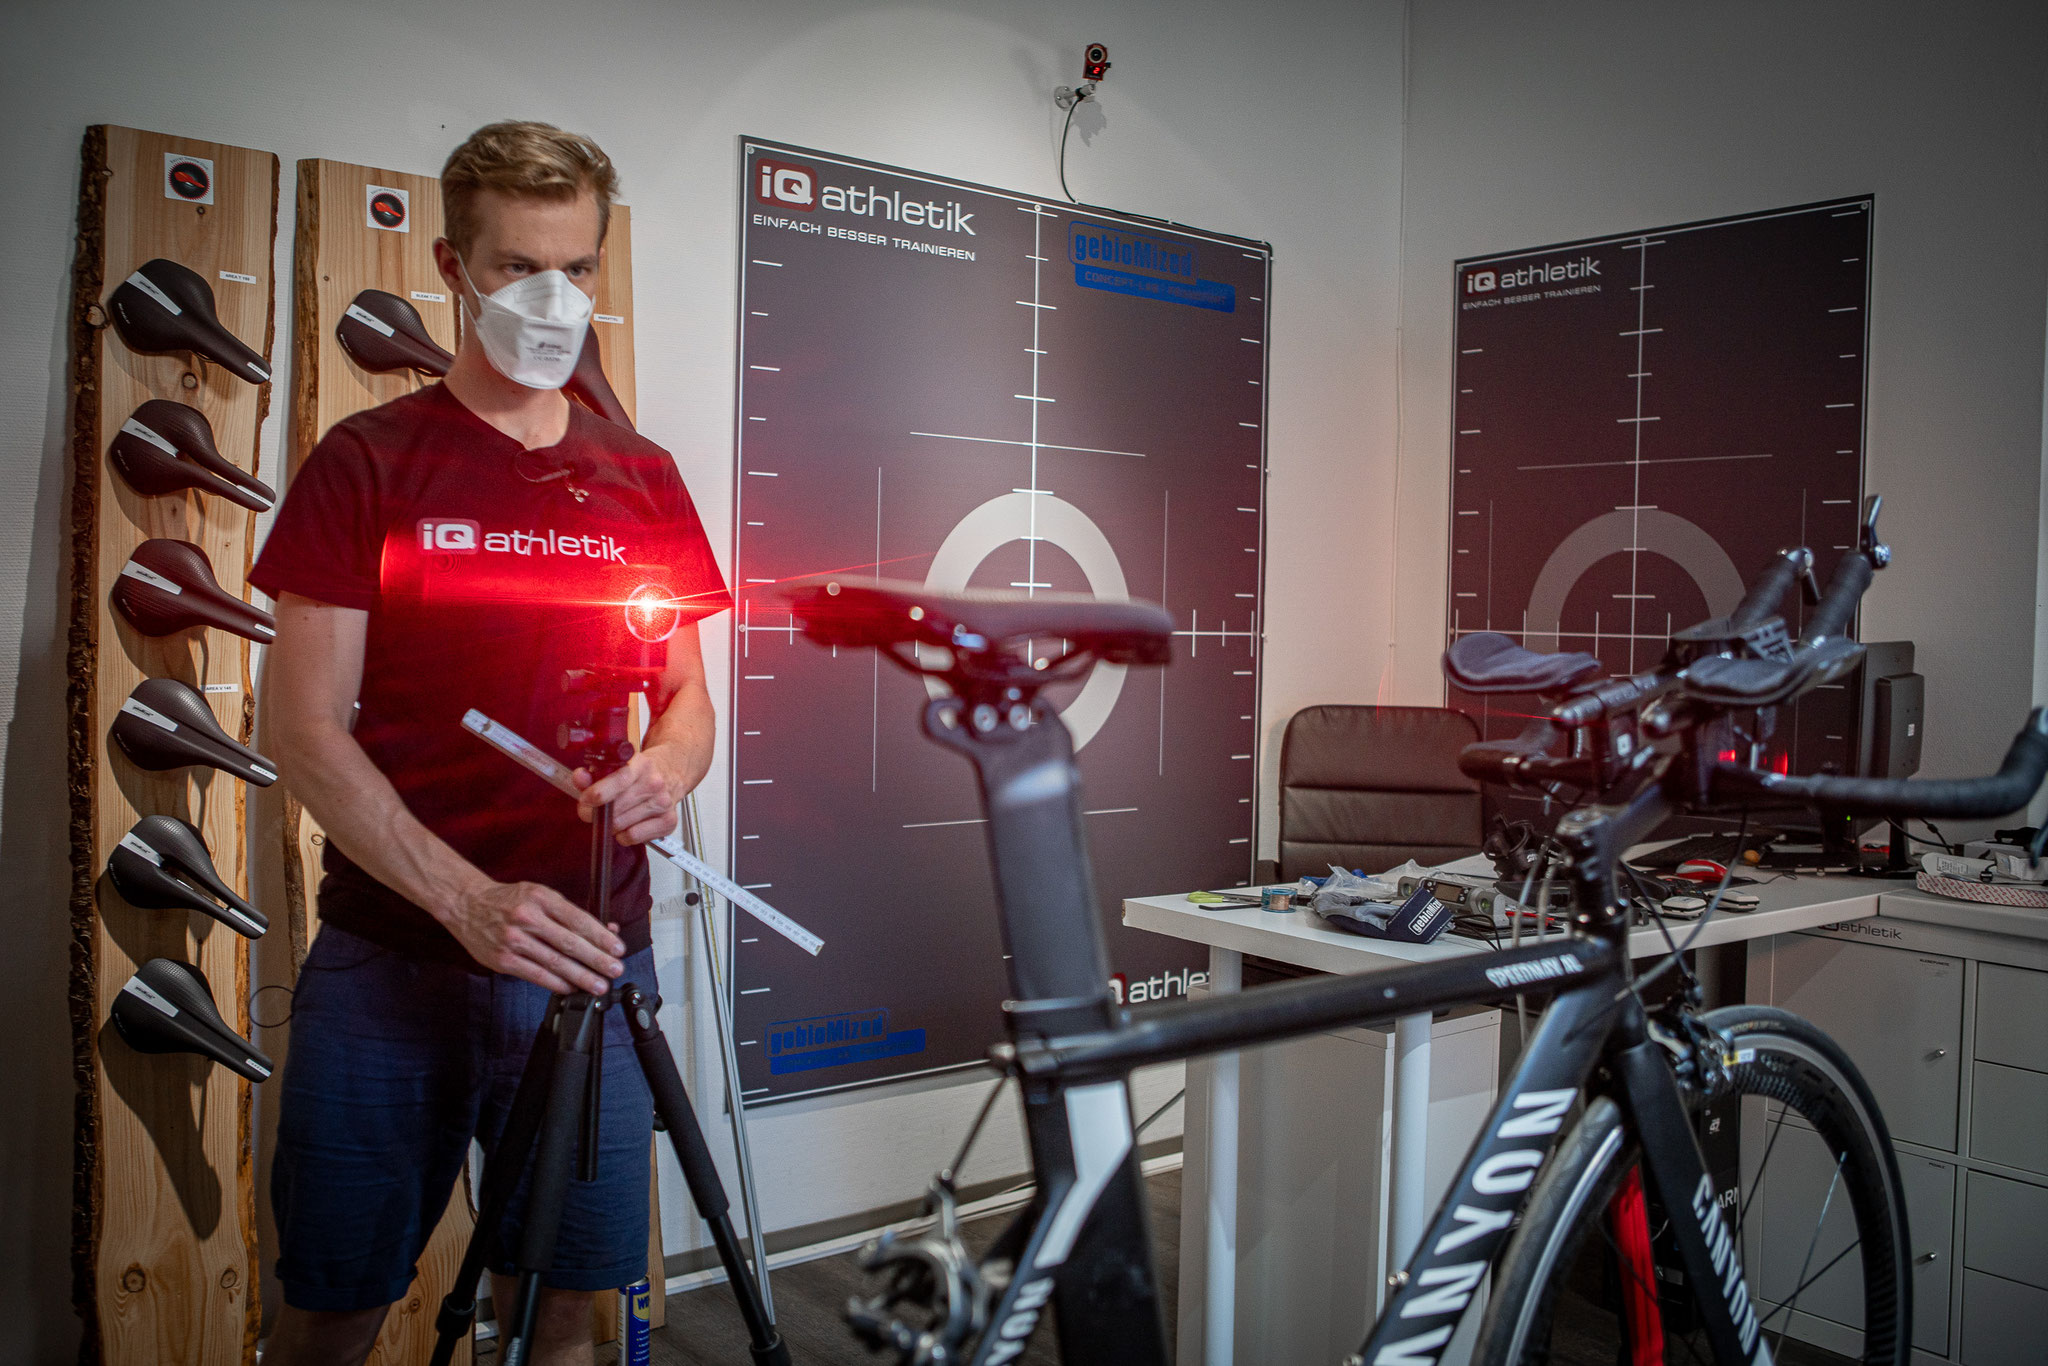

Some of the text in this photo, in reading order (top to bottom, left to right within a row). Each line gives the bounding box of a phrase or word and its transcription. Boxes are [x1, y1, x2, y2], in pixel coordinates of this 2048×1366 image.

[761, 165, 976, 236] iQ athletik
[752, 213, 976, 261] EINFACH BESSER TRAINIEREN
[1074, 233, 1192, 277] gebioMized
[1466, 255, 1602, 294] iQ athletik
[1462, 284, 1602, 311] EINFACH BESSER TRAINIEREN
[422, 522, 628, 566] iQ athletik
[1839, 922, 1903, 941] athletik
[1128, 966, 1210, 1004] athle
[1373, 1088, 1579, 1366] ANYON
[1691, 1172, 1760, 1357] CANYON
